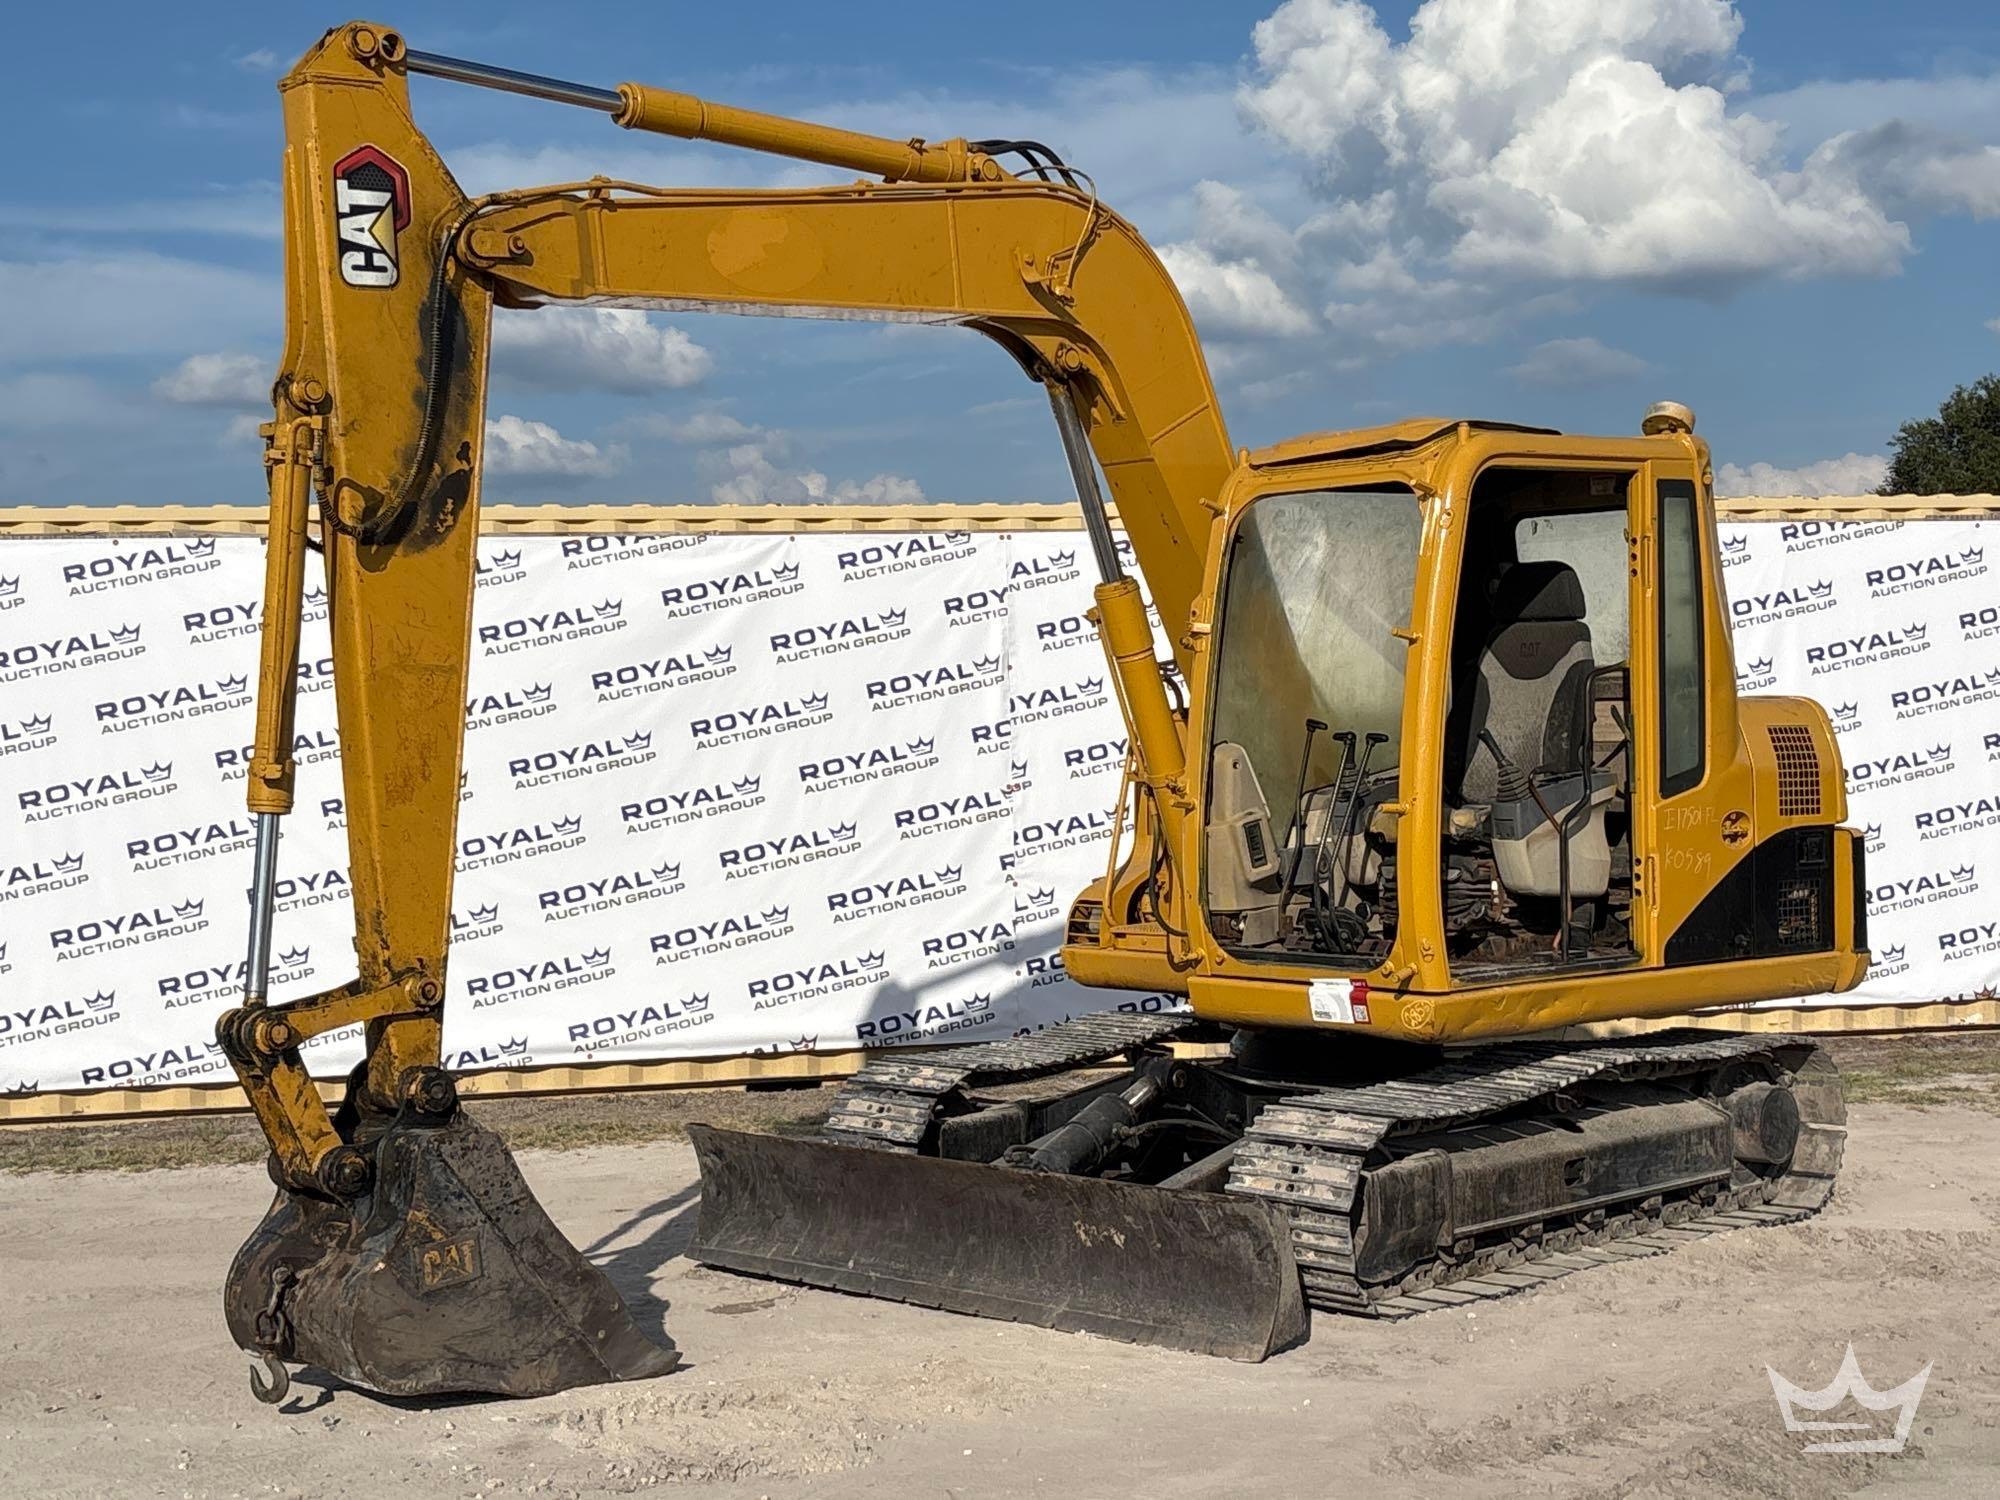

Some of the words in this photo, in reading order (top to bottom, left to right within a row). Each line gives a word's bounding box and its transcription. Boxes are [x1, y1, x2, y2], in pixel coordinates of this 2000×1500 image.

[336, 179, 398, 286] CAT
[567, 547, 644, 570] AUCTION
[647, 535, 708, 554] GROUP
[838, 536, 945, 569] ROYAL
[1786, 533, 1851, 554] AUCTION
[1854, 521, 1905, 539] GROUP
[63, 547, 185, 583] ROYAL
[70, 573, 152, 596] AUCTION
[156, 560, 221, 579] GROUP
[476, 571, 527, 588] ROUP
[844, 560, 916, 582] AUCTION
[920, 548, 976, 566] GROUP
[1024, 570, 1081, 590] GROUP
[1866, 555, 1960, 586] ROYAL
[1872, 578, 1935, 598] AUCTION
[1938, 567, 1987, 583] GROUP
[662, 571, 772, 606] ROYAL
[668, 597, 742, 619] AUCTION
[746, 583, 804, 602] GROUP
[944, 587, 1007, 615] ROY
[1732, 588, 1809, 616] OYAL
[183, 601, 258, 631] ROY
[479, 608, 593, 643] ROYAL
[949, 608, 1009, 628] AUCTIO
[1785, 599, 1838, 617] GROUP
[485, 634, 562, 656] AUCTION
[567, 620, 627, 639] GROUP
[770, 617, 879, 652] ROYAL
[776, 642, 850, 664] AUCTION
[854, 629, 911, 647] GROUP
[1042, 632, 1100, 652] AUCTIO
[1807, 631, 1903, 663] ROYAL
[80, 646, 145, 666] GROUP
[592, 654, 704, 690] ROYAL
[1812, 656, 1877, 675] AUCTION
[1880, 644, 1930, 660] GROUP
[598, 679, 673, 702] AUCTION
[677, 666, 736, 685] GROUP
[866, 664, 973, 699] ROYAL
[872, 689, 944, 711] AUCTION
[948, 677, 1004, 694] GROUP
[1737, 676, 1778, 692] ROUP
[1891, 675, 1985, 708] ROYAL
[95, 684, 217, 721] ROYAL
[102, 710, 184, 734] AUCTION
[188, 696, 252, 716] GROUP
[496, 704, 556, 724] GROUP
[690, 702, 801, 737] ROYAL
[1052, 697, 1108, 717] GROUP
[1897, 701, 1960, 720] AUCTION
[1963, 688, 2000, 704] GROU
[0, 736, 57, 757] ROUP
[696, 727, 771, 750] AUCTION
[775, 713, 833, 732] GROUP
[307, 749, 343, 764] GRO
[509, 740, 622, 777] ROYAL
[799, 746, 907, 782] ROYAL
[1064, 738, 1127, 767] ROY
[1070, 759, 1127, 779] AUCTIO
[515, 766, 592, 790] AUCTION
[596, 752, 656, 772] GROUP
[805, 771, 878, 794] AUCTION
[882, 759, 939, 777] GROUP
[1846, 776, 1901, 795] UCTION
[1904, 763, 1956, 781] GROUP
[18, 771, 142, 809] ROYAL
[25, 798, 108, 823] AUCTION
[113, 783, 177, 804] GROUP
[621, 785, 733, 821] ROYAL
[627, 811, 702, 834] AUCTION
[706, 798, 765, 816] GROUP
[894, 792, 1001, 828] ROYAL
[900, 819, 972, 840] AUCTION
[976, 806, 1013, 823] GRO
[127, 820, 249, 859] ROYAL
[456, 825, 553, 857] OYAL
[1014, 813, 1105, 845] OYAL
[1919, 819, 1984, 841] AUCTION
[134, 847, 215, 872] AUCTION
[455, 851, 521, 873] UCTION
[525, 837, 586, 857] GROUP
[720, 831, 828, 868] ROYAL
[726, 857, 800, 881] AUCTION
[803, 844, 861, 862] GROUP
[1016, 837, 1076, 858] UCTION
[23, 874, 89, 896] GROUP
[539, 872, 652, 909] ROYAL
[827, 874, 935, 911] ROYAL
[1927, 883, 1979, 903] GROUP
[545, 897, 621, 922] AUCTION
[625, 884, 685, 903] GROUP
[834, 902, 906, 923] AUCTION
[910, 885, 967, 907] GROUP
[1015, 908, 1060, 925] ROUP
[50, 909, 172, 948] ROYAL
[57, 936, 139, 962] AUCTION
[144, 922, 209, 941] GROUP
[650, 915, 762, 953] ROYAL
[923, 920, 1015, 956] ROYA
[1939, 922, 2000, 950] ROY
[656, 942, 731, 966] AUCTION
[735, 929, 794, 946] GROUP
[928, 945, 999, 969] AUCTION
[268, 968, 315, 985] ROUP
[467, 957, 582, 996] ROYAL
[473, 984, 551, 1009] AUCTION
[555, 971, 615, 989] GROUP
[748, 960, 858, 998] ROYAL
[754, 988, 828, 1011] AUCTION
[832, 970, 890, 992] GROUP
[55, 1012, 120, 1034] GROUP
[568, 1004, 681, 1042] ROYAL
[573, 1031, 651, 1053] AUCTION
[654, 1013, 715, 1035] GROUP
[856, 1002, 965, 1039] ROYAL
[939, 1012, 995, 1034] GROUP
[82, 1045, 205, 1085] ROYAL
[174, 1059, 228, 1079] GROU
